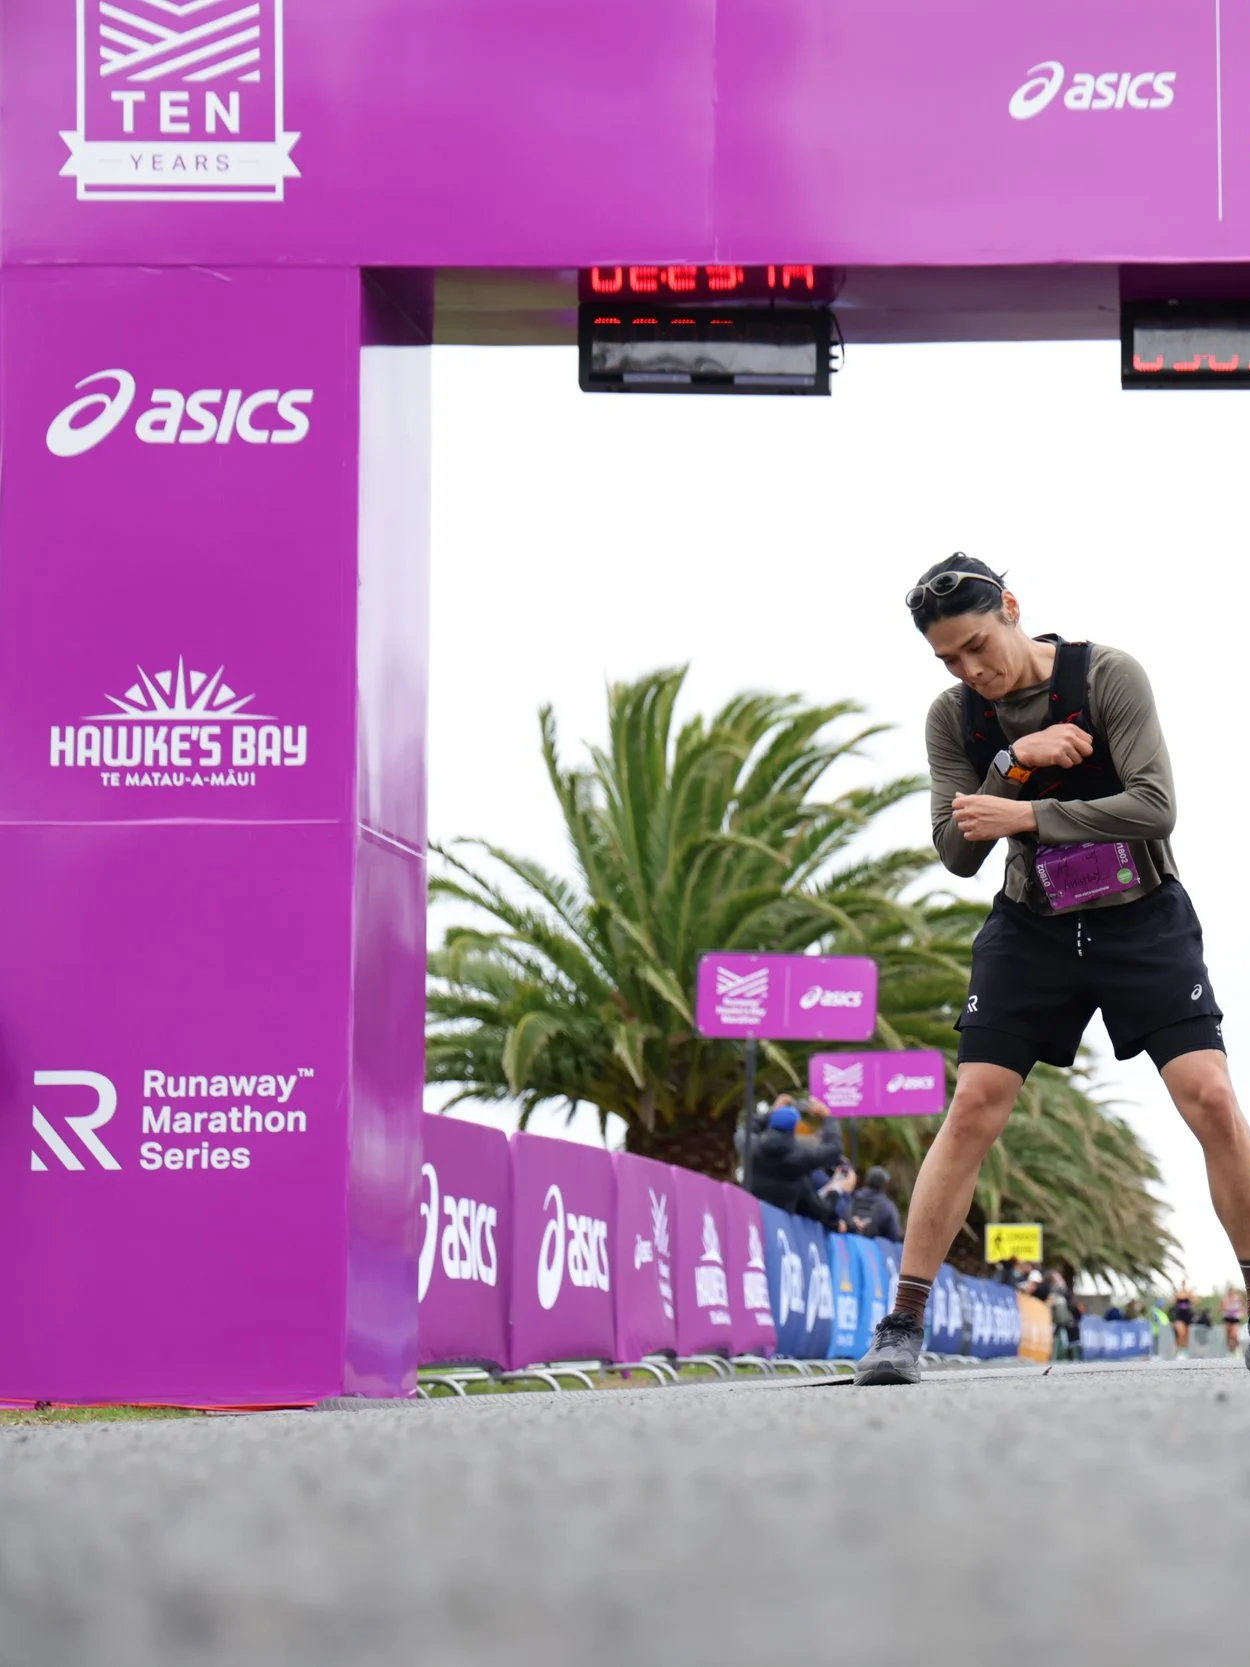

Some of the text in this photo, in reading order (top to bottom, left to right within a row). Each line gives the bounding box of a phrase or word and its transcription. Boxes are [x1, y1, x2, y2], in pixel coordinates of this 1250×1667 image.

[110, 90, 240, 133] TEN
[131, 155, 229, 171] YEARS
[50, 725, 307, 767] HAWKE'S BAY
[100, 772, 120, 787] TE
[142, 1105, 307, 1134] Marathon
[139, 1141, 251, 1171] Series
